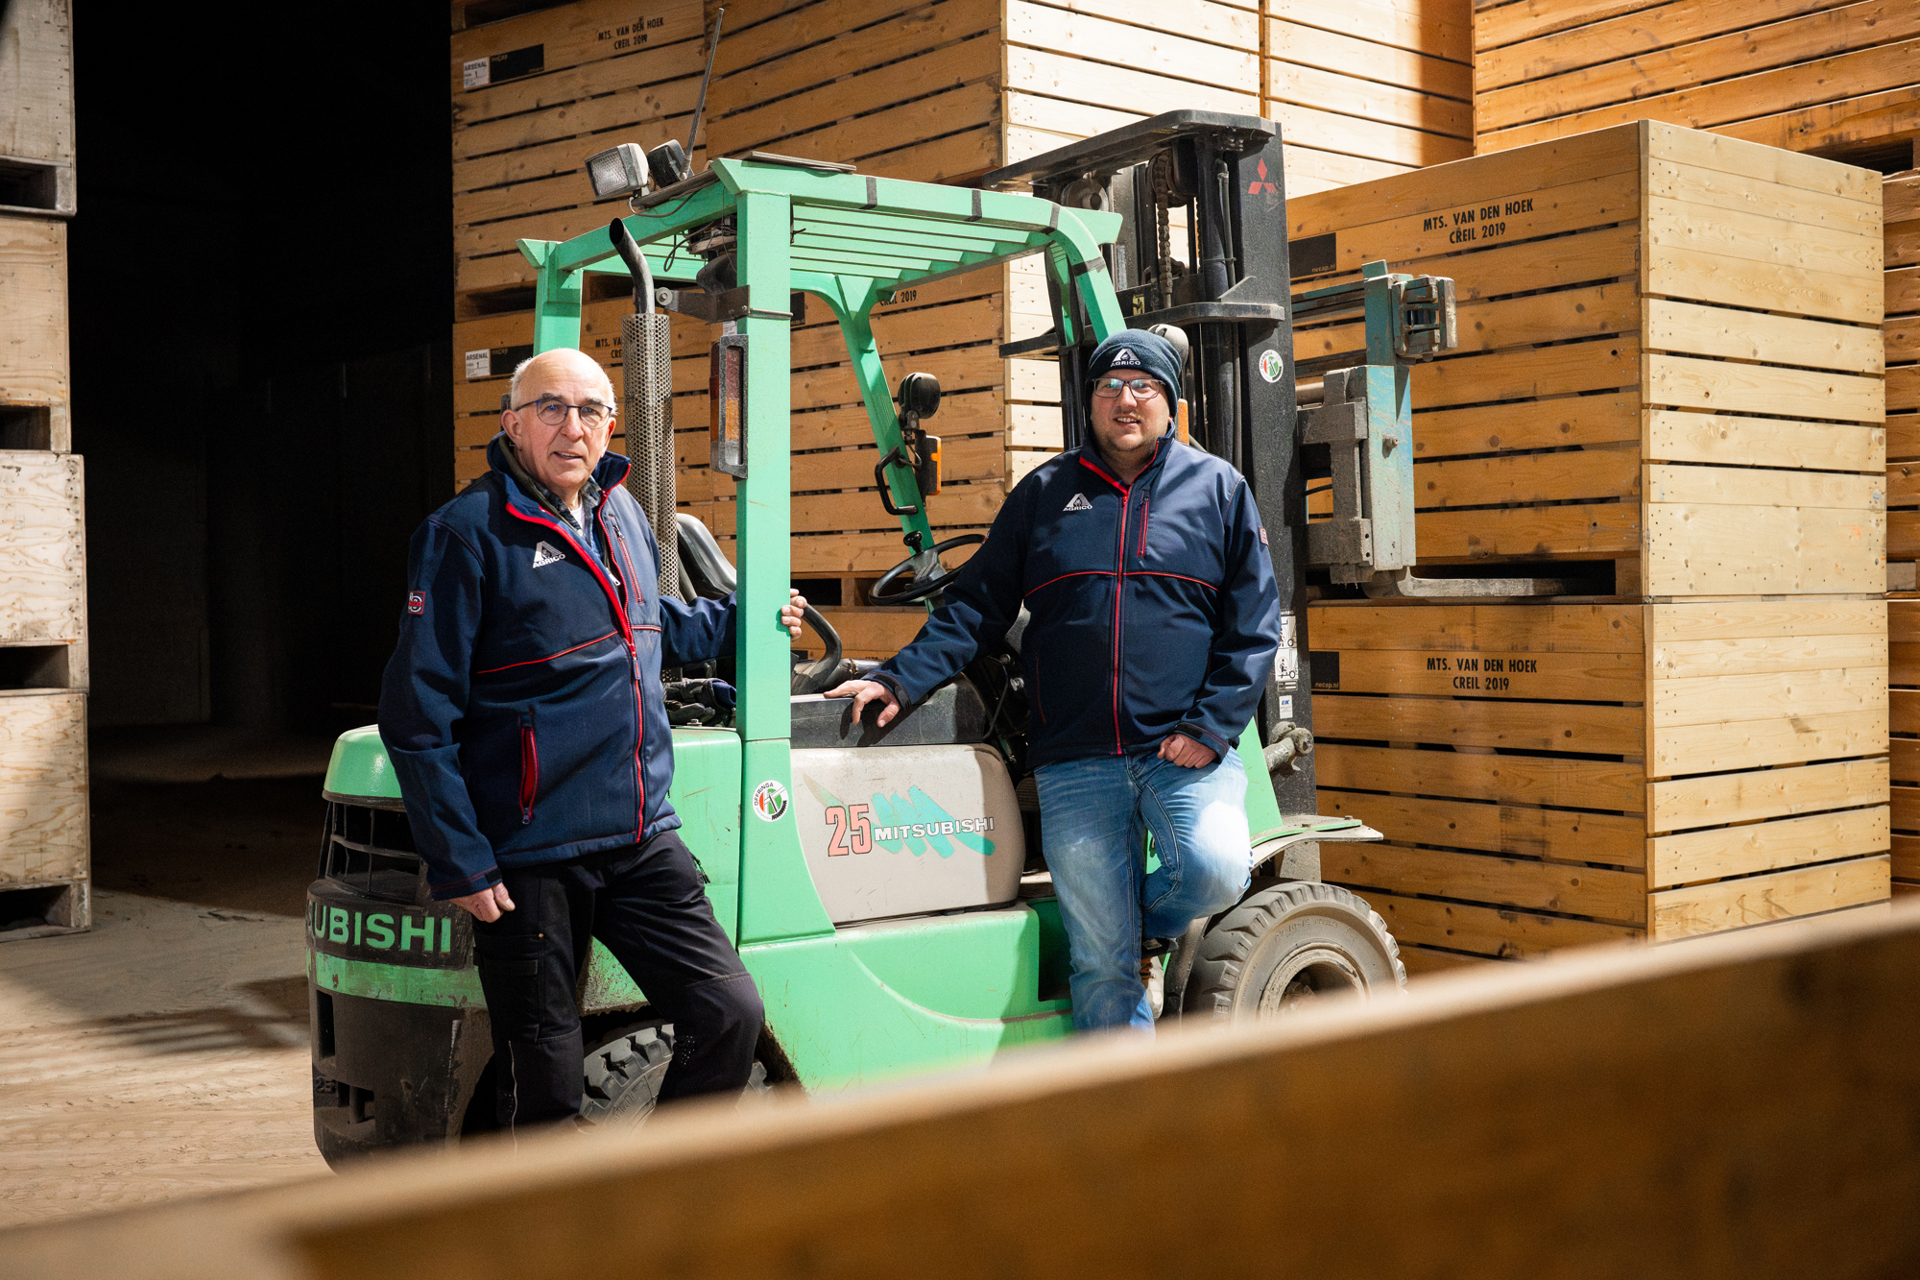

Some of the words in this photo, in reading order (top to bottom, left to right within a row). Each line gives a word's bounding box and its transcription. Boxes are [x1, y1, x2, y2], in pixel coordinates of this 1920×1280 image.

[616, 25, 630, 37] VAN
[632, 21, 645, 33] DEN
[647, 17, 664, 29] HOEK
[614, 38, 630, 50] CREIL
[464, 61, 487, 71] ARSENAL
[1423, 216, 1448, 232] MTS.
[1453, 210, 1475, 226] VAN
[1480, 205, 1500, 221] DEN
[1505, 198, 1534, 216] HOEK
[1449, 228, 1476, 244] CREIL
[1482, 222, 1506, 239] 2019
[901, 290, 917, 303] 2019
[613, 336, 622, 346] VA
[466, 352, 488, 361] ARSENAL
[611, 348, 622, 358] CRE
[532, 553, 566, 569] AGRICO
[1427, 657, 1451, 671] MTS.
[1456, 658, 1478, 671] VAN
[1484, 659, 1504, 672] DEN
[1509, 659, 1537, 673] HOEK
[1453, 676, 1480, 690] CREIL
[1485, 677, 1509, 691] 2019
[754, 782, 774, 806] OFFRINGA
[825, 804, 872, 857] 25
[874, 817, 995, 842] MITSUBISHI
